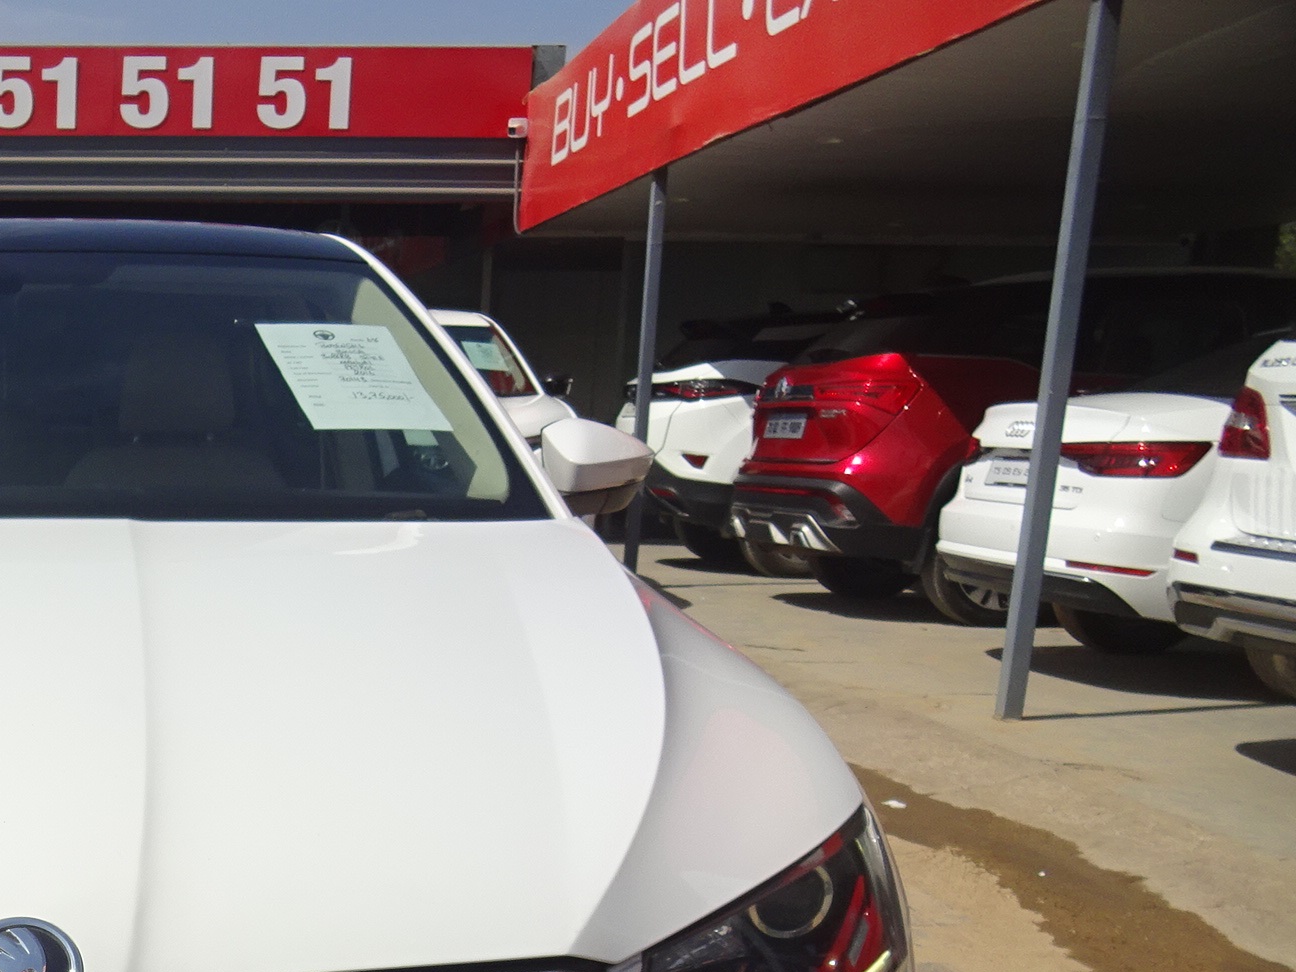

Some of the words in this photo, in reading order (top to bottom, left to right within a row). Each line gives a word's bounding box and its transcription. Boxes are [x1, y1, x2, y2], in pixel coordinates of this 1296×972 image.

[120, 56, 214, 129] 51
[257, 57, 352, 130] 51
[551, 54, 614, 166] BUY
